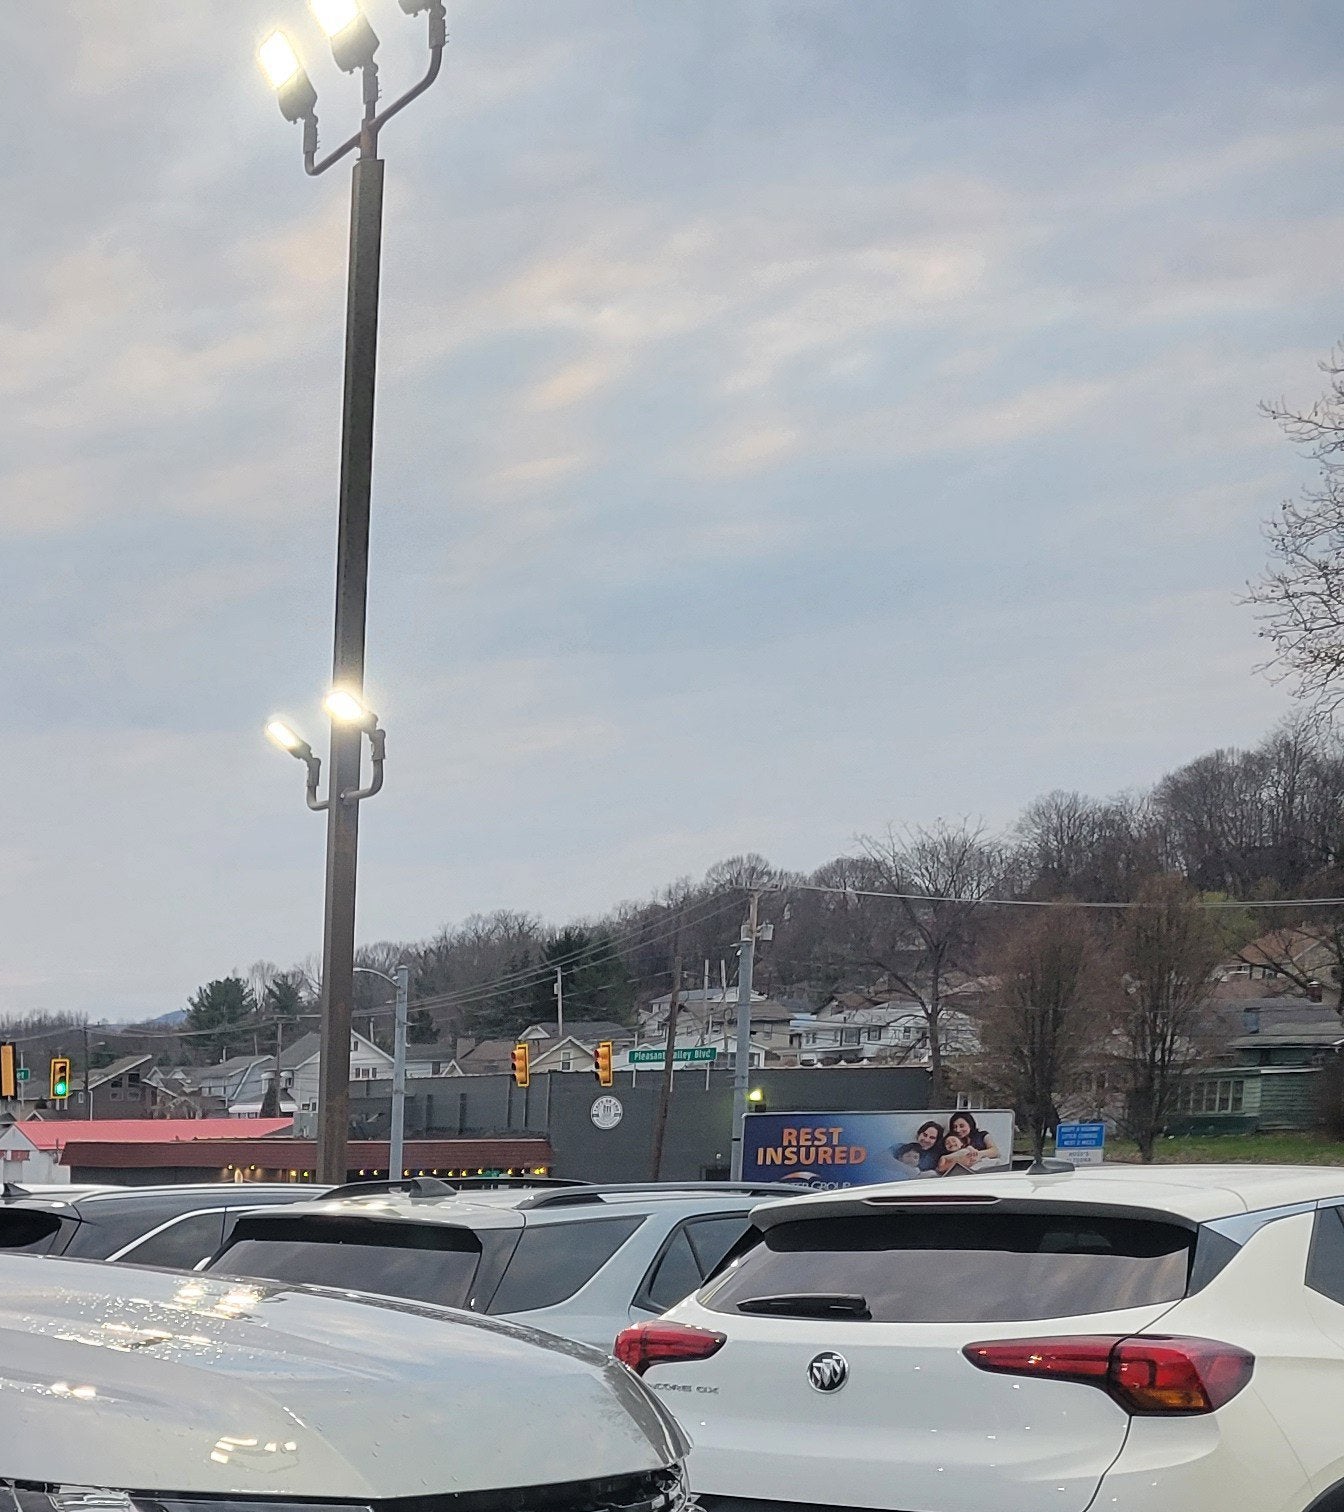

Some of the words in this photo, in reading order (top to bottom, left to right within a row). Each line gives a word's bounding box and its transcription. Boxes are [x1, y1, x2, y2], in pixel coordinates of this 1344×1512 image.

[634, 1051, 666, 1061] Pleasant
[672, 1050, 692, 1060] alley
[694, 1048, 711, 1059] Blvd
[782, 1127, 844, 1146] REST
[756, 1146, 868, 1166] INSURED
